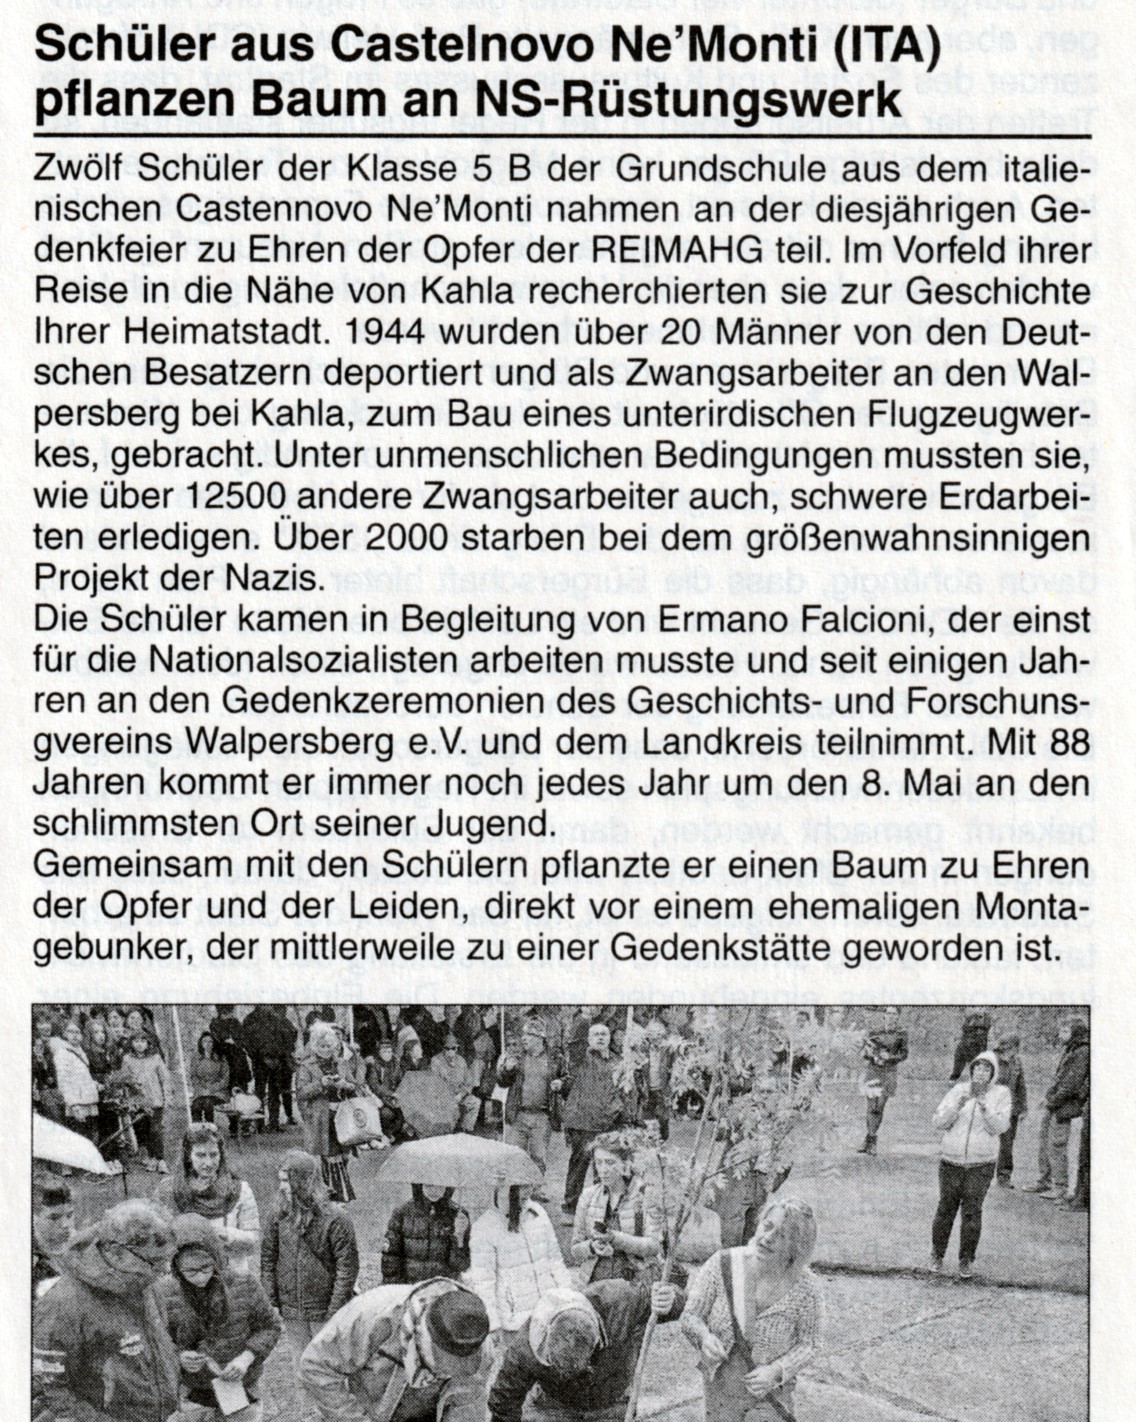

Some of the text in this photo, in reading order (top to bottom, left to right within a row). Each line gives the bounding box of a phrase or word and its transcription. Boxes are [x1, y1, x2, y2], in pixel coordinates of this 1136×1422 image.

[35, 22, 217, 62] Schüler
[231, 32, 315, 62] aus
[331, 23, 595, 63] Castelnovo
[834, 24, 941, 73] (ITA)
[35, 77, 903, 128] pflanzen Baum an NS-Rüstungswerk
[33, 151, 1091, 183] Zwölf Schüler der Klasse 5 B der Grundschule aus dem italie-
[34, 233, 1093, 271] denkfeier zu Ehren der Opfer der REIMAHG teil. Im Vorfeld ihrer
[34, 398, 1091, 436] persberg bei Kahla, zum Bau eines unterirdischen Flugzeugwer-
[33, 480, 1091, 518] wie über 12500 andere Zwangsarbeiter auch, schwere Erdarbei-
[35, 562, 325, 599] Projekt der Nazis.
[32, 643, 1090, 682] für die Nationalsozialisten arbeiten musste und seit einigen Jah-
[33, 725, 1091, 763] gvereins Walpersberg e.V. und dem Landkreis teilnimmt. Mit 88
[33, 806, 556, 845] schlimmsten Ort seiner Jugend.
